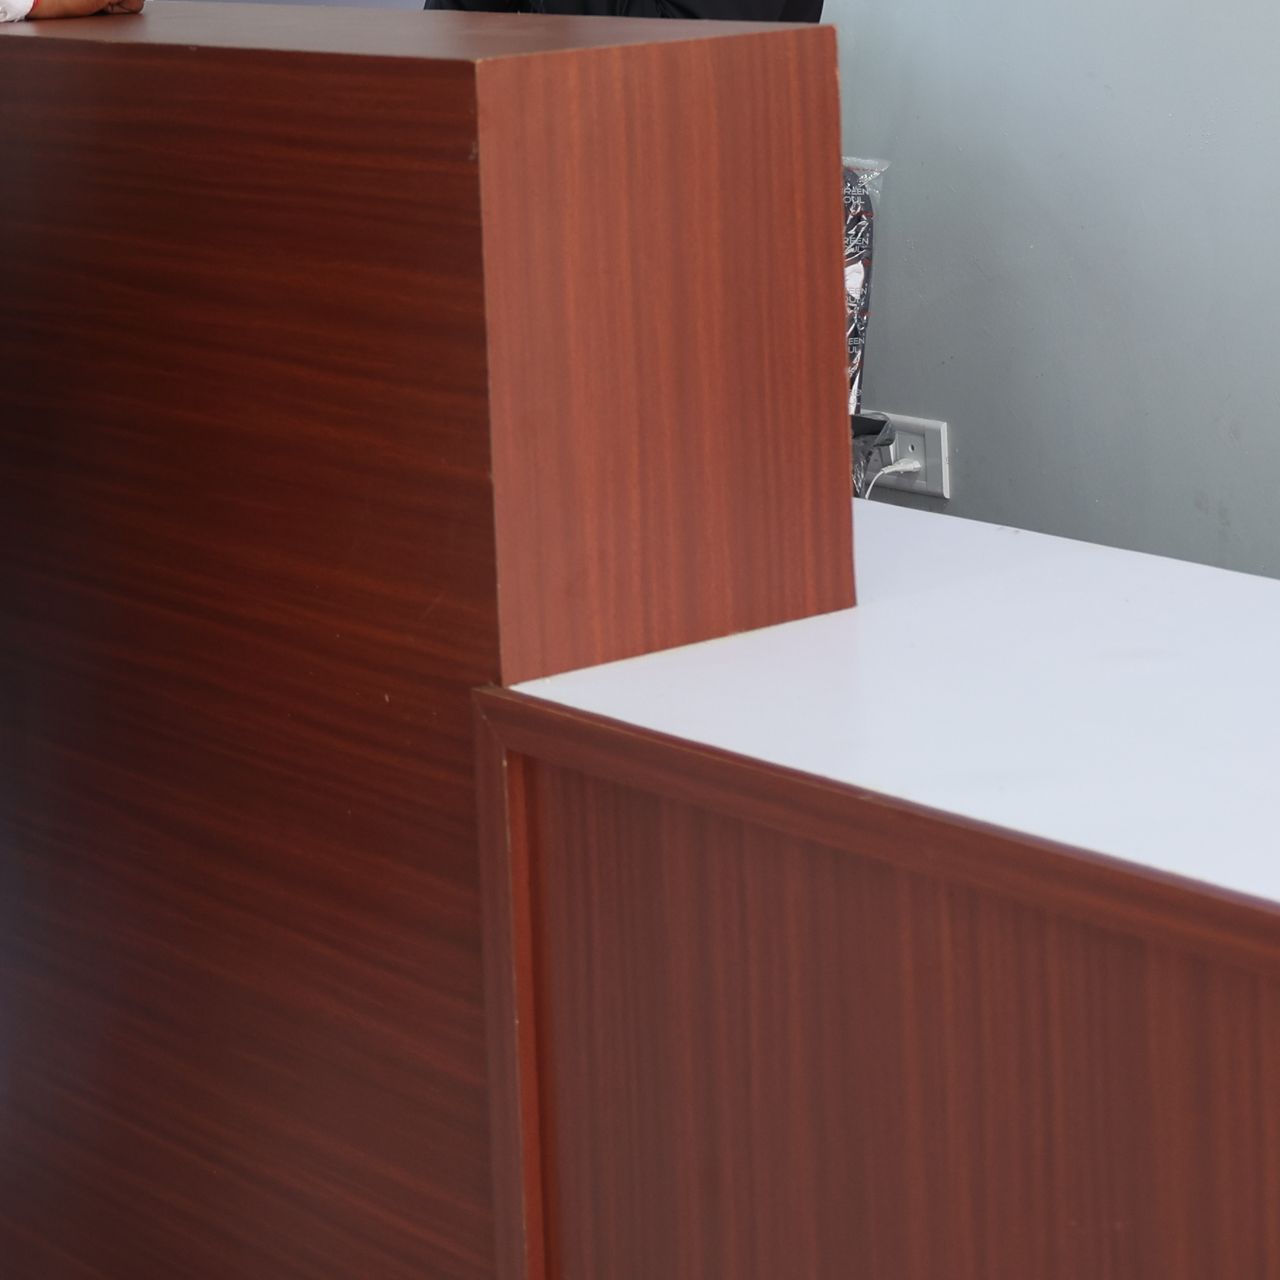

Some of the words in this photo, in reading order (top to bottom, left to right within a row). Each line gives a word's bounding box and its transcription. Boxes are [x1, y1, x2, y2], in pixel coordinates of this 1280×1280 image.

[844, 187, 869, 196] REEN
[843, 196, 865, 204] OUL
[844, 237, 869, 245] REEN
[848, 337, 865, 345] EEN
[848, 345, 860, 354] UL
